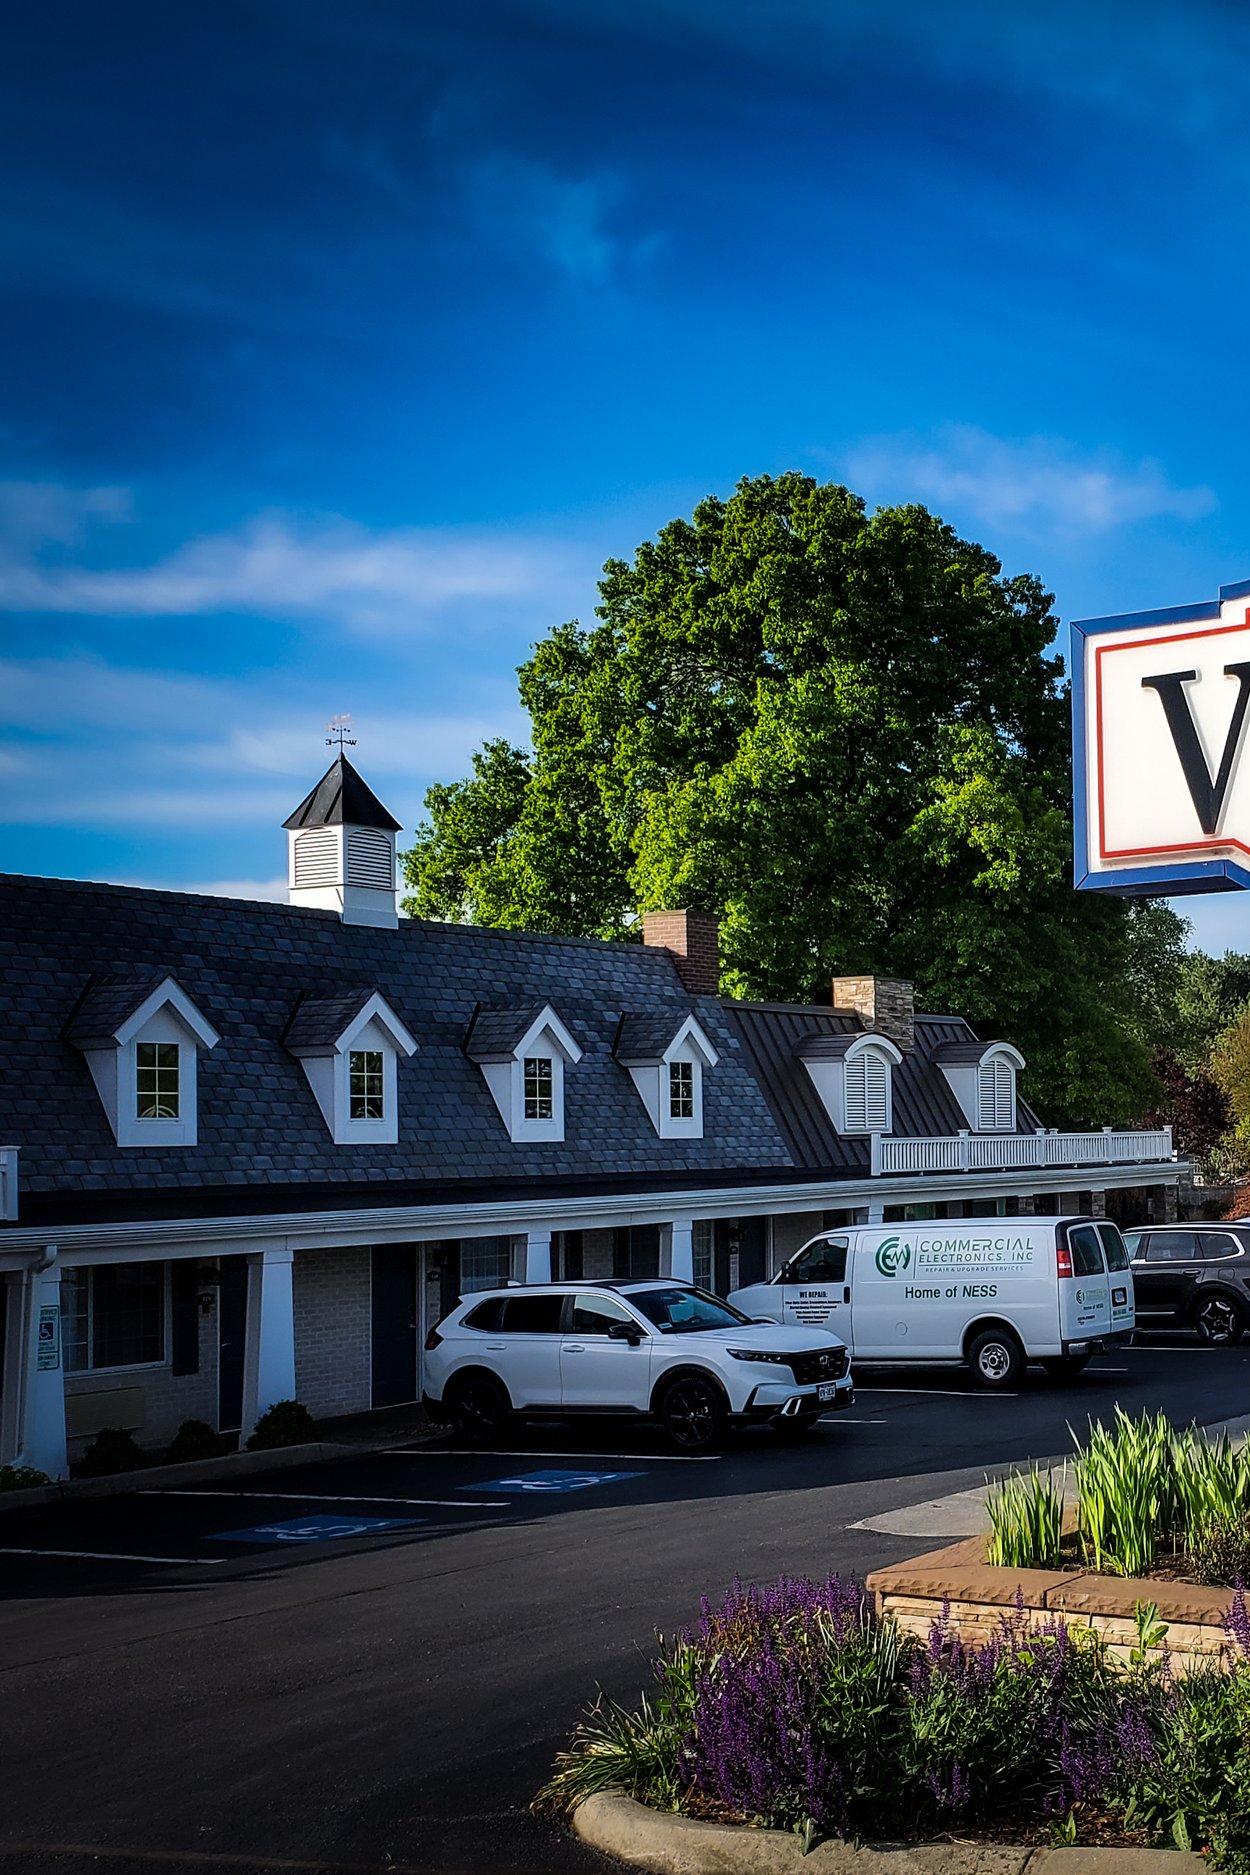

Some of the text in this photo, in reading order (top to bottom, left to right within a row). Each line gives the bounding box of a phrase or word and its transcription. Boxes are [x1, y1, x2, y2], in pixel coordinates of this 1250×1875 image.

[920, 1237, 1034, 1253] COMMERCIAL
[1012, 1252, 1033, 1261] INC
[905, 1284, 998, 1299] Home of NESS
